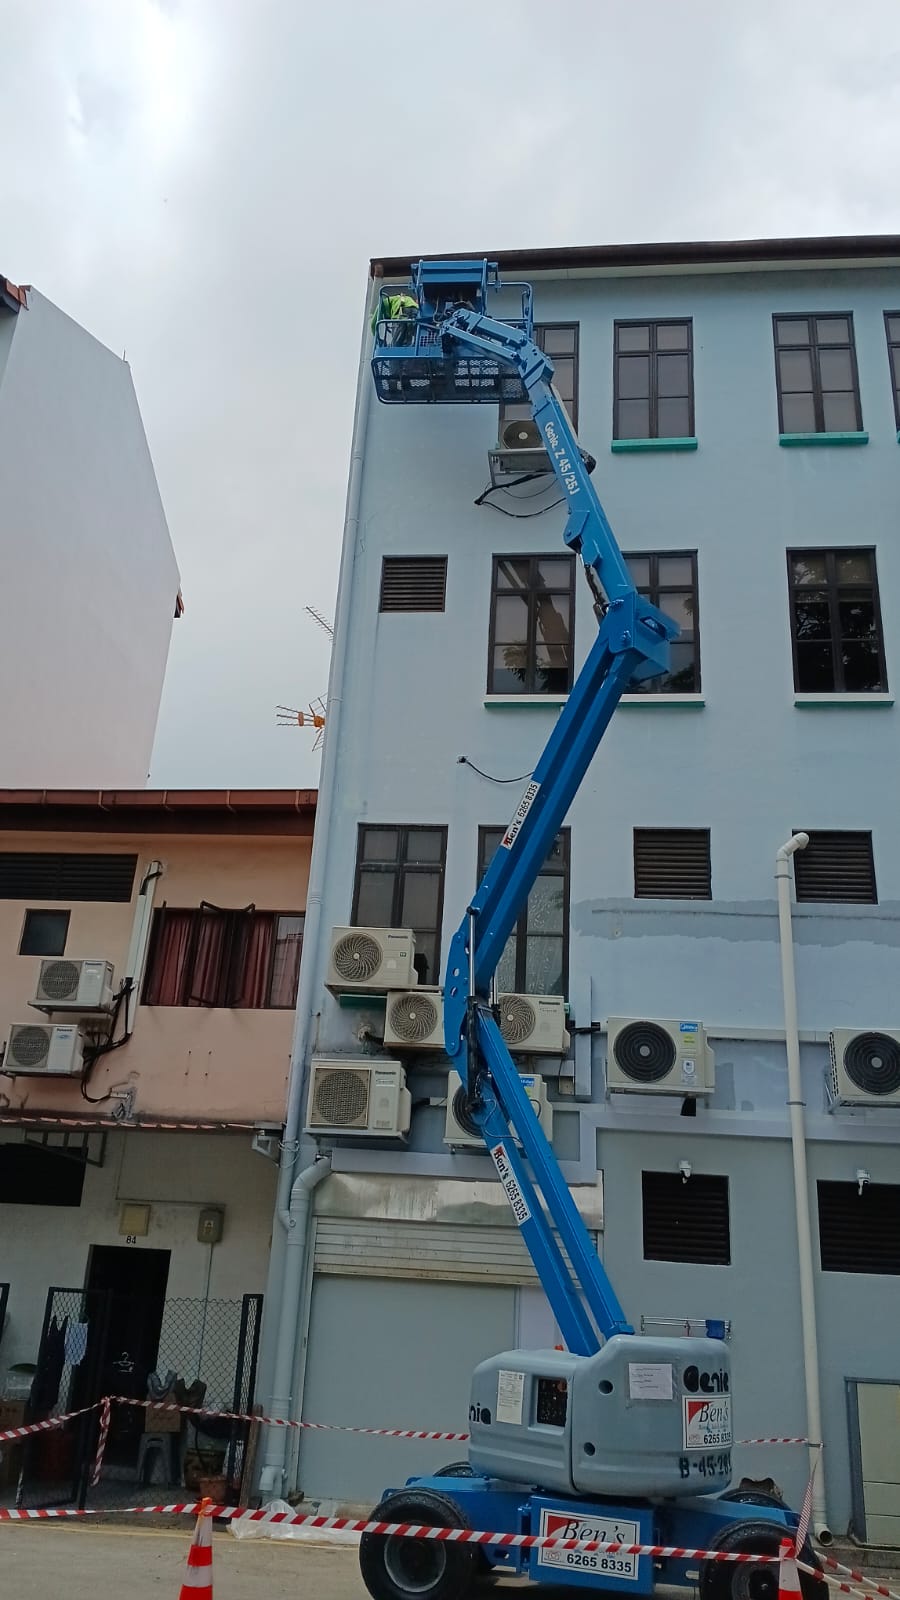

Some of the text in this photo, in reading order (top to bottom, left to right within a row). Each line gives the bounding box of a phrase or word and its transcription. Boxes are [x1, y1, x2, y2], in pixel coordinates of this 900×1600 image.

[544, 421, 559, 449] Genie
[553, 448, 566, 460] Z
[505, 783, 538, 847] Ben's 6265 8335
[493, 1149, 528, 1221] Ben's 6265 8335
[126, 1235, 137, 1244] 84
[699, 1401, 729, 1423] Ben's
[703, 1433, 720, 1445] 6265
[562, 1519, 626, 1545] Ben's
[566, 1553, 597, 1568] 6265
[600, 1558, 632, 1573] 8335
